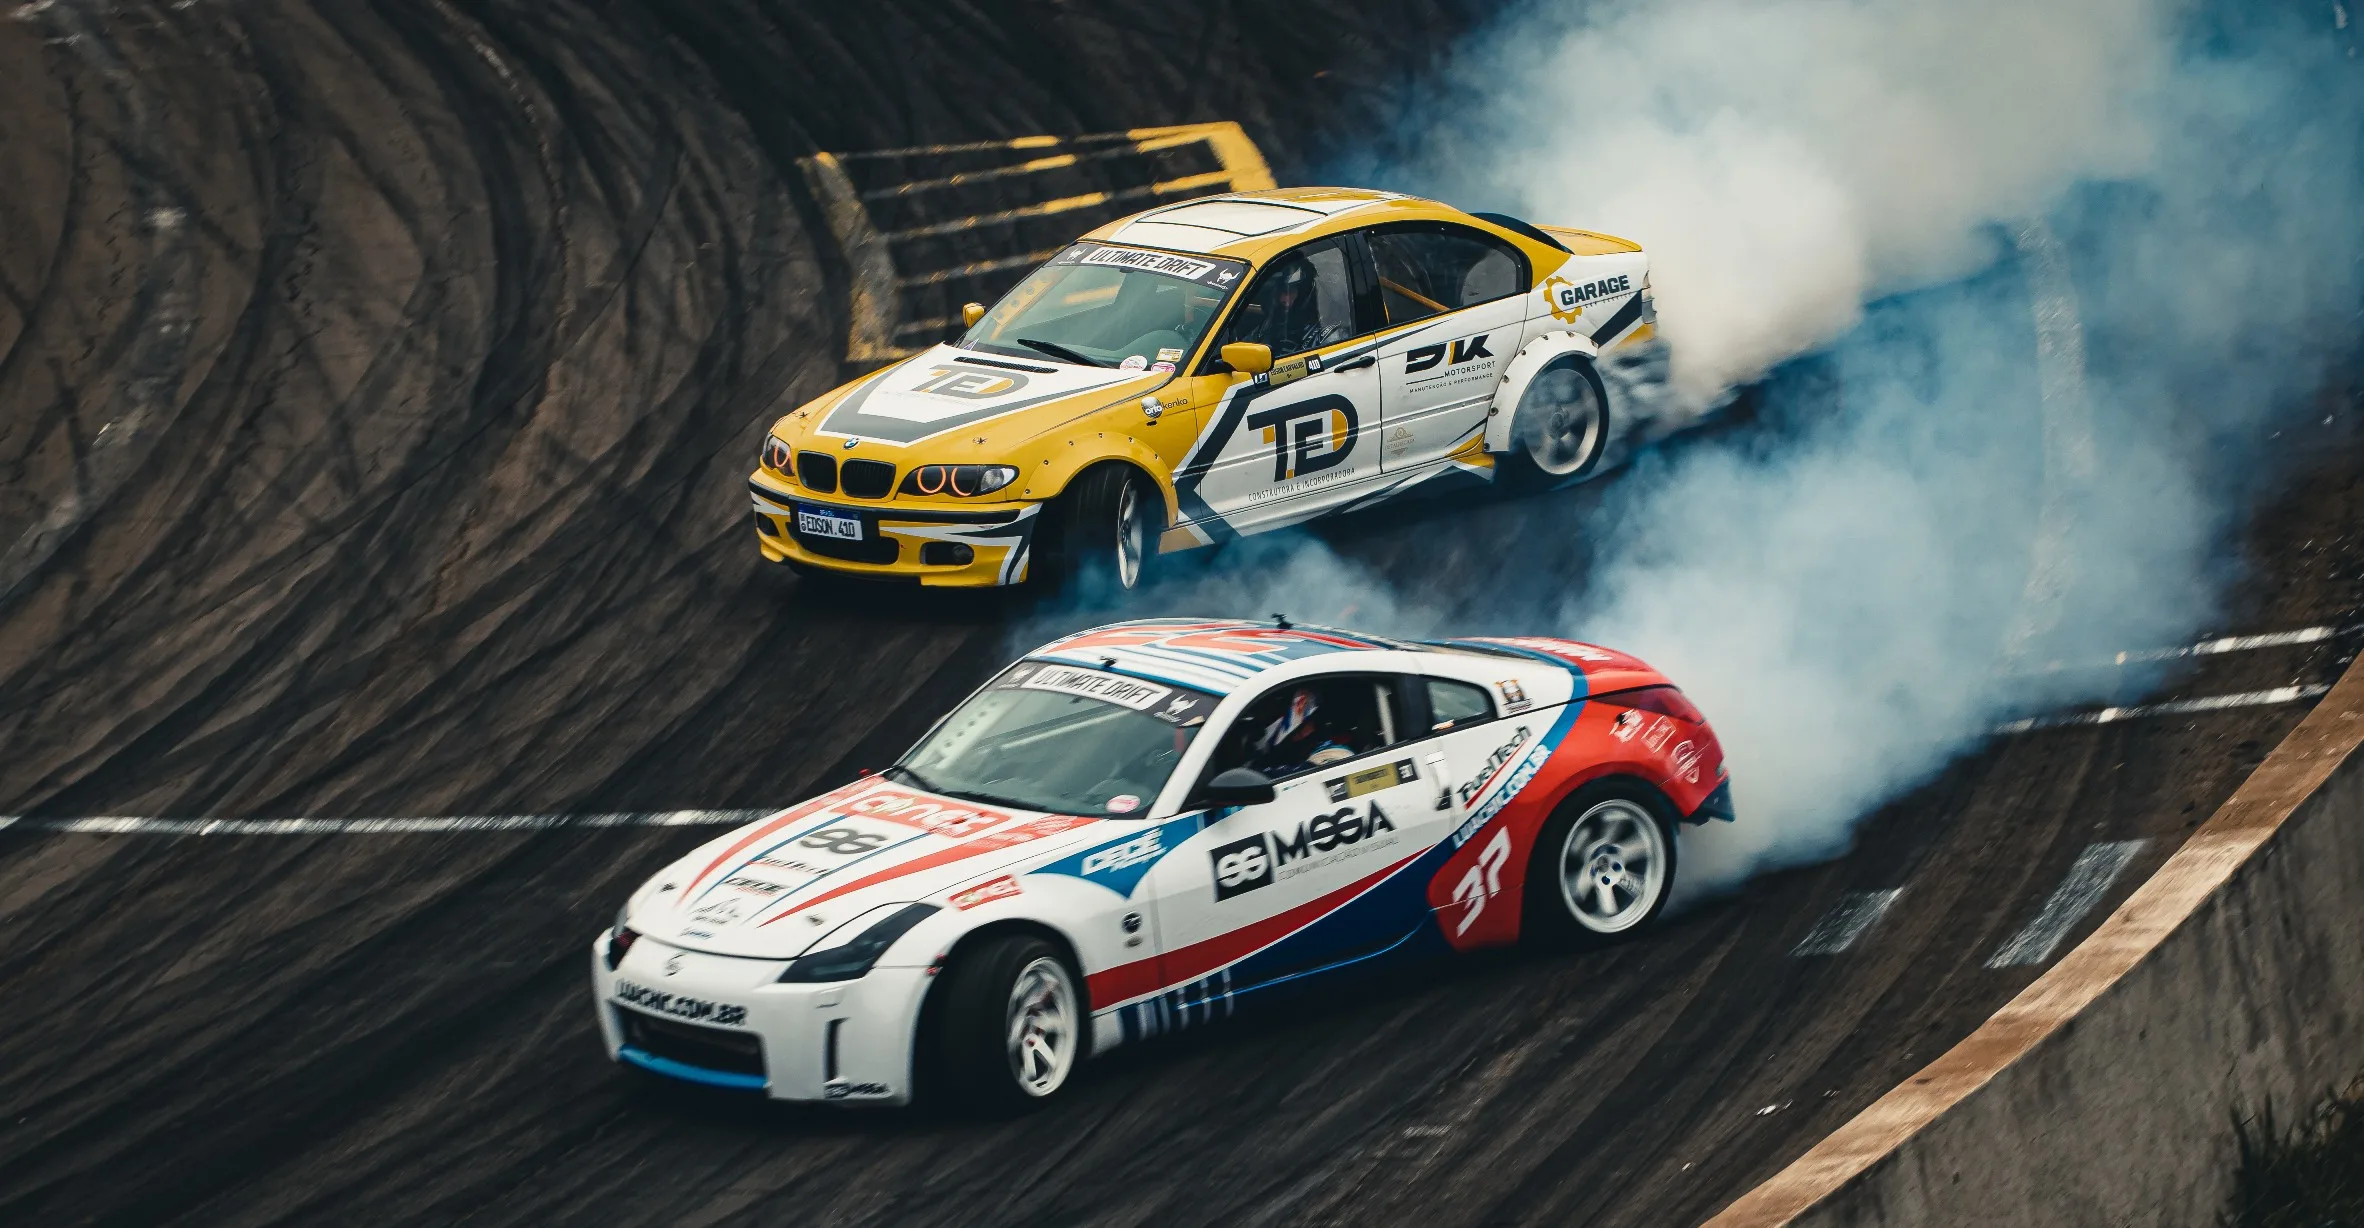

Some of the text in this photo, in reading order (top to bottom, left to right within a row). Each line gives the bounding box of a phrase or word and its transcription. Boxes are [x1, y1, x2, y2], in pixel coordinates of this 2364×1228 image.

[1089, 249, 1208, 276] ULTIMATE DRIFT
[1560, 274, 1630, 306] GARAGE
[1308, 359, 1320, 371] 410
[1444, 360, 1496, 378] MOTORSPORT
[1247, 393, 1359, 482] TED
[1248, 481, 1295, 502] CONSTRUTORA
[1302, 467, 1356, 490] INCORPORADORA
[1034, 669, 1110, 692] ULTIMATE
[1101, 681, 1160, 704] DRIFT
[1457, 725, 1531, 802] FuelTech
[1452, 825, 1512, 938] 37
